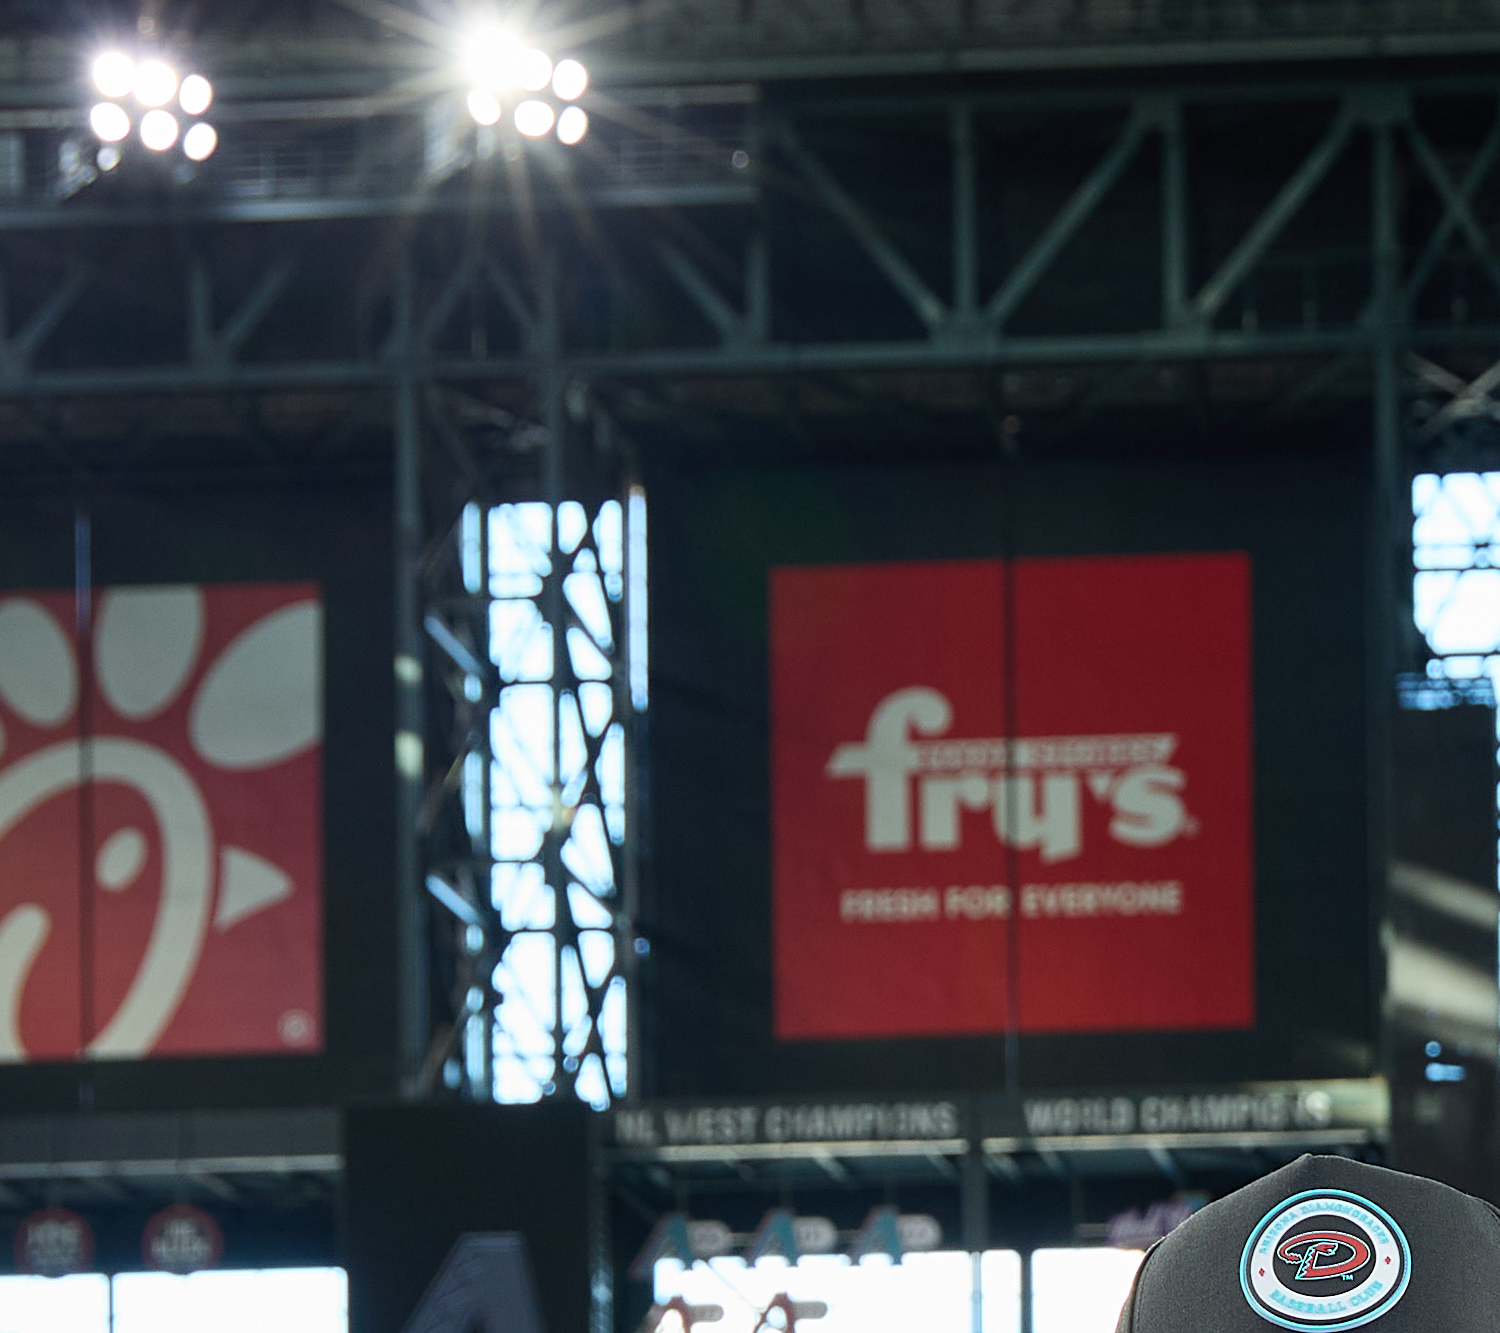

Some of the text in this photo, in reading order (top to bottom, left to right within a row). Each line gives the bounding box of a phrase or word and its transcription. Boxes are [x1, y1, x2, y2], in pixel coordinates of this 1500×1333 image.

[825, 684, 1190, 864] fry's
[840, 879, 1184, 922] FRESH FOR EVERYONE
[1300, 1201, 1389, 1245] DIAMONDBACKS
[1269, 1280, 1383, 1314] BASEBALL CLUB
